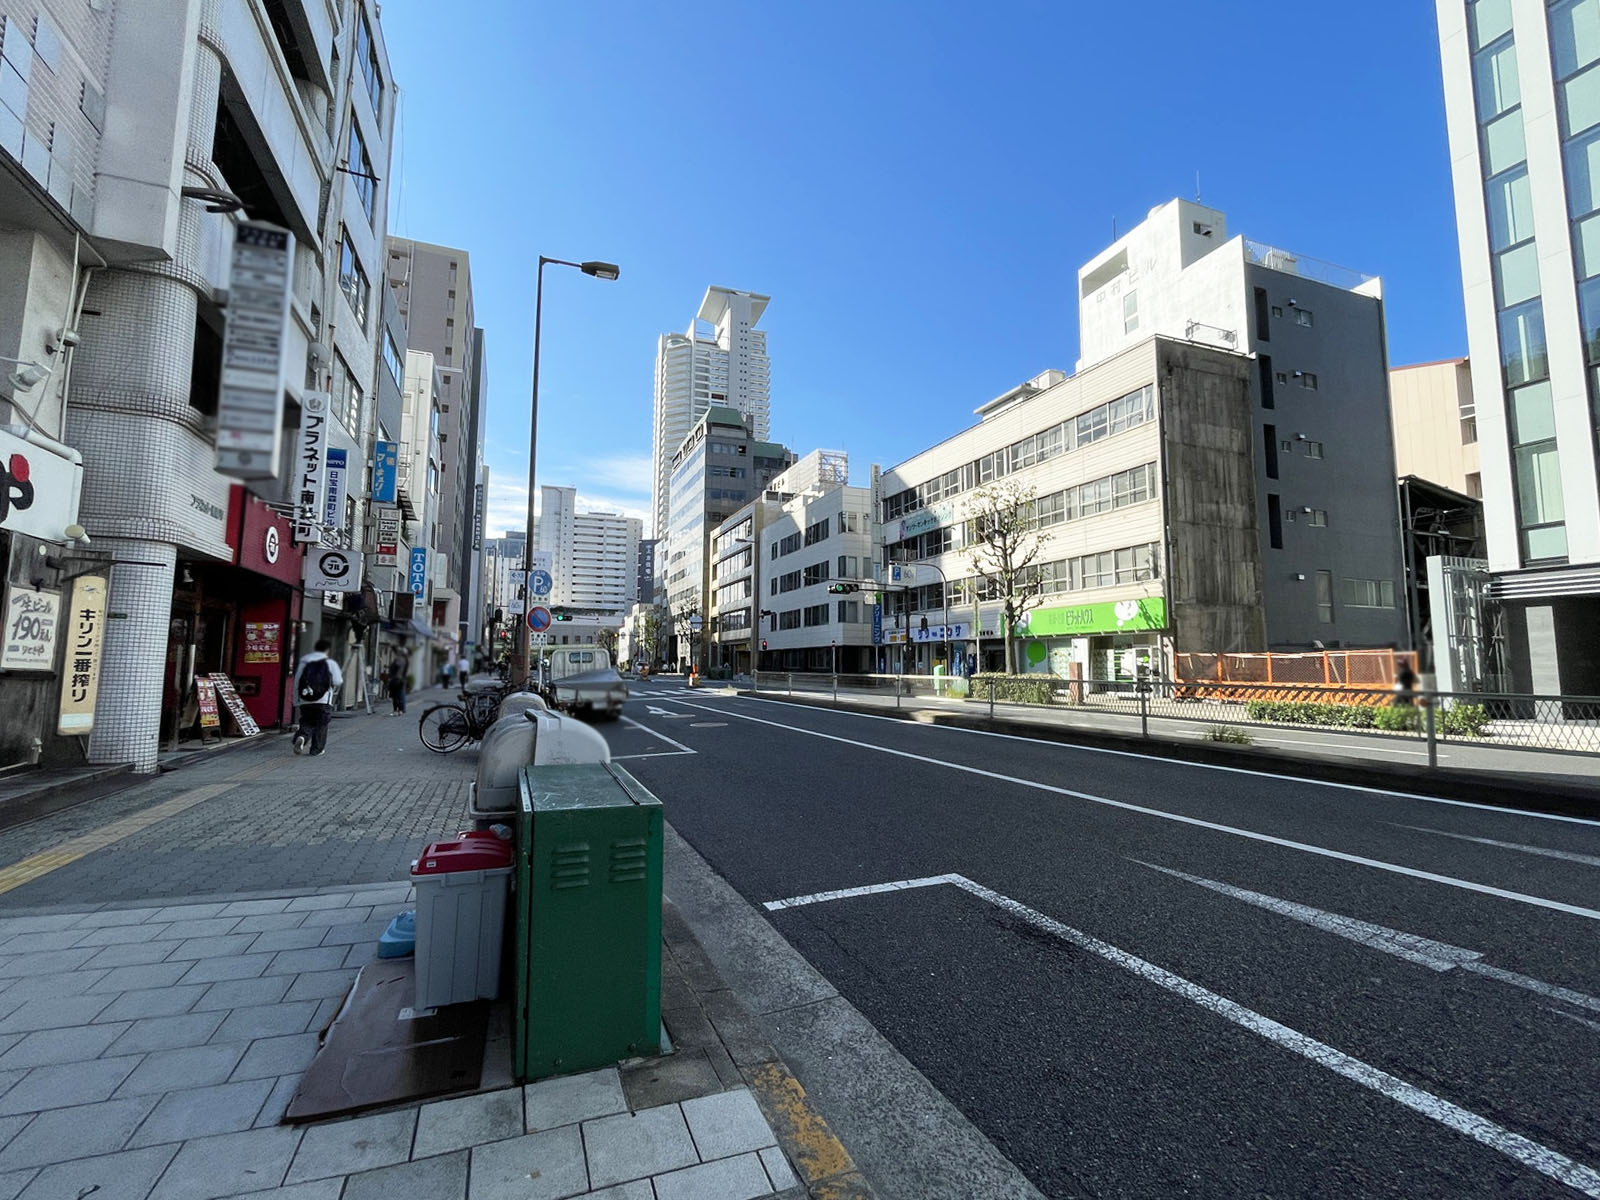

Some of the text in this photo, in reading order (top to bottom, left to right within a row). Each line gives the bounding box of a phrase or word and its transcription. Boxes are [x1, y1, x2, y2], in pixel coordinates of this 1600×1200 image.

[298, 415, 324, 537] プラネット南町
[411, 553, 425, 594] TOTO
[534, 576, 544, 593] P
[12, 614, 41, 640] 190
[72, 608, 97, 703] キリン一番搾り
